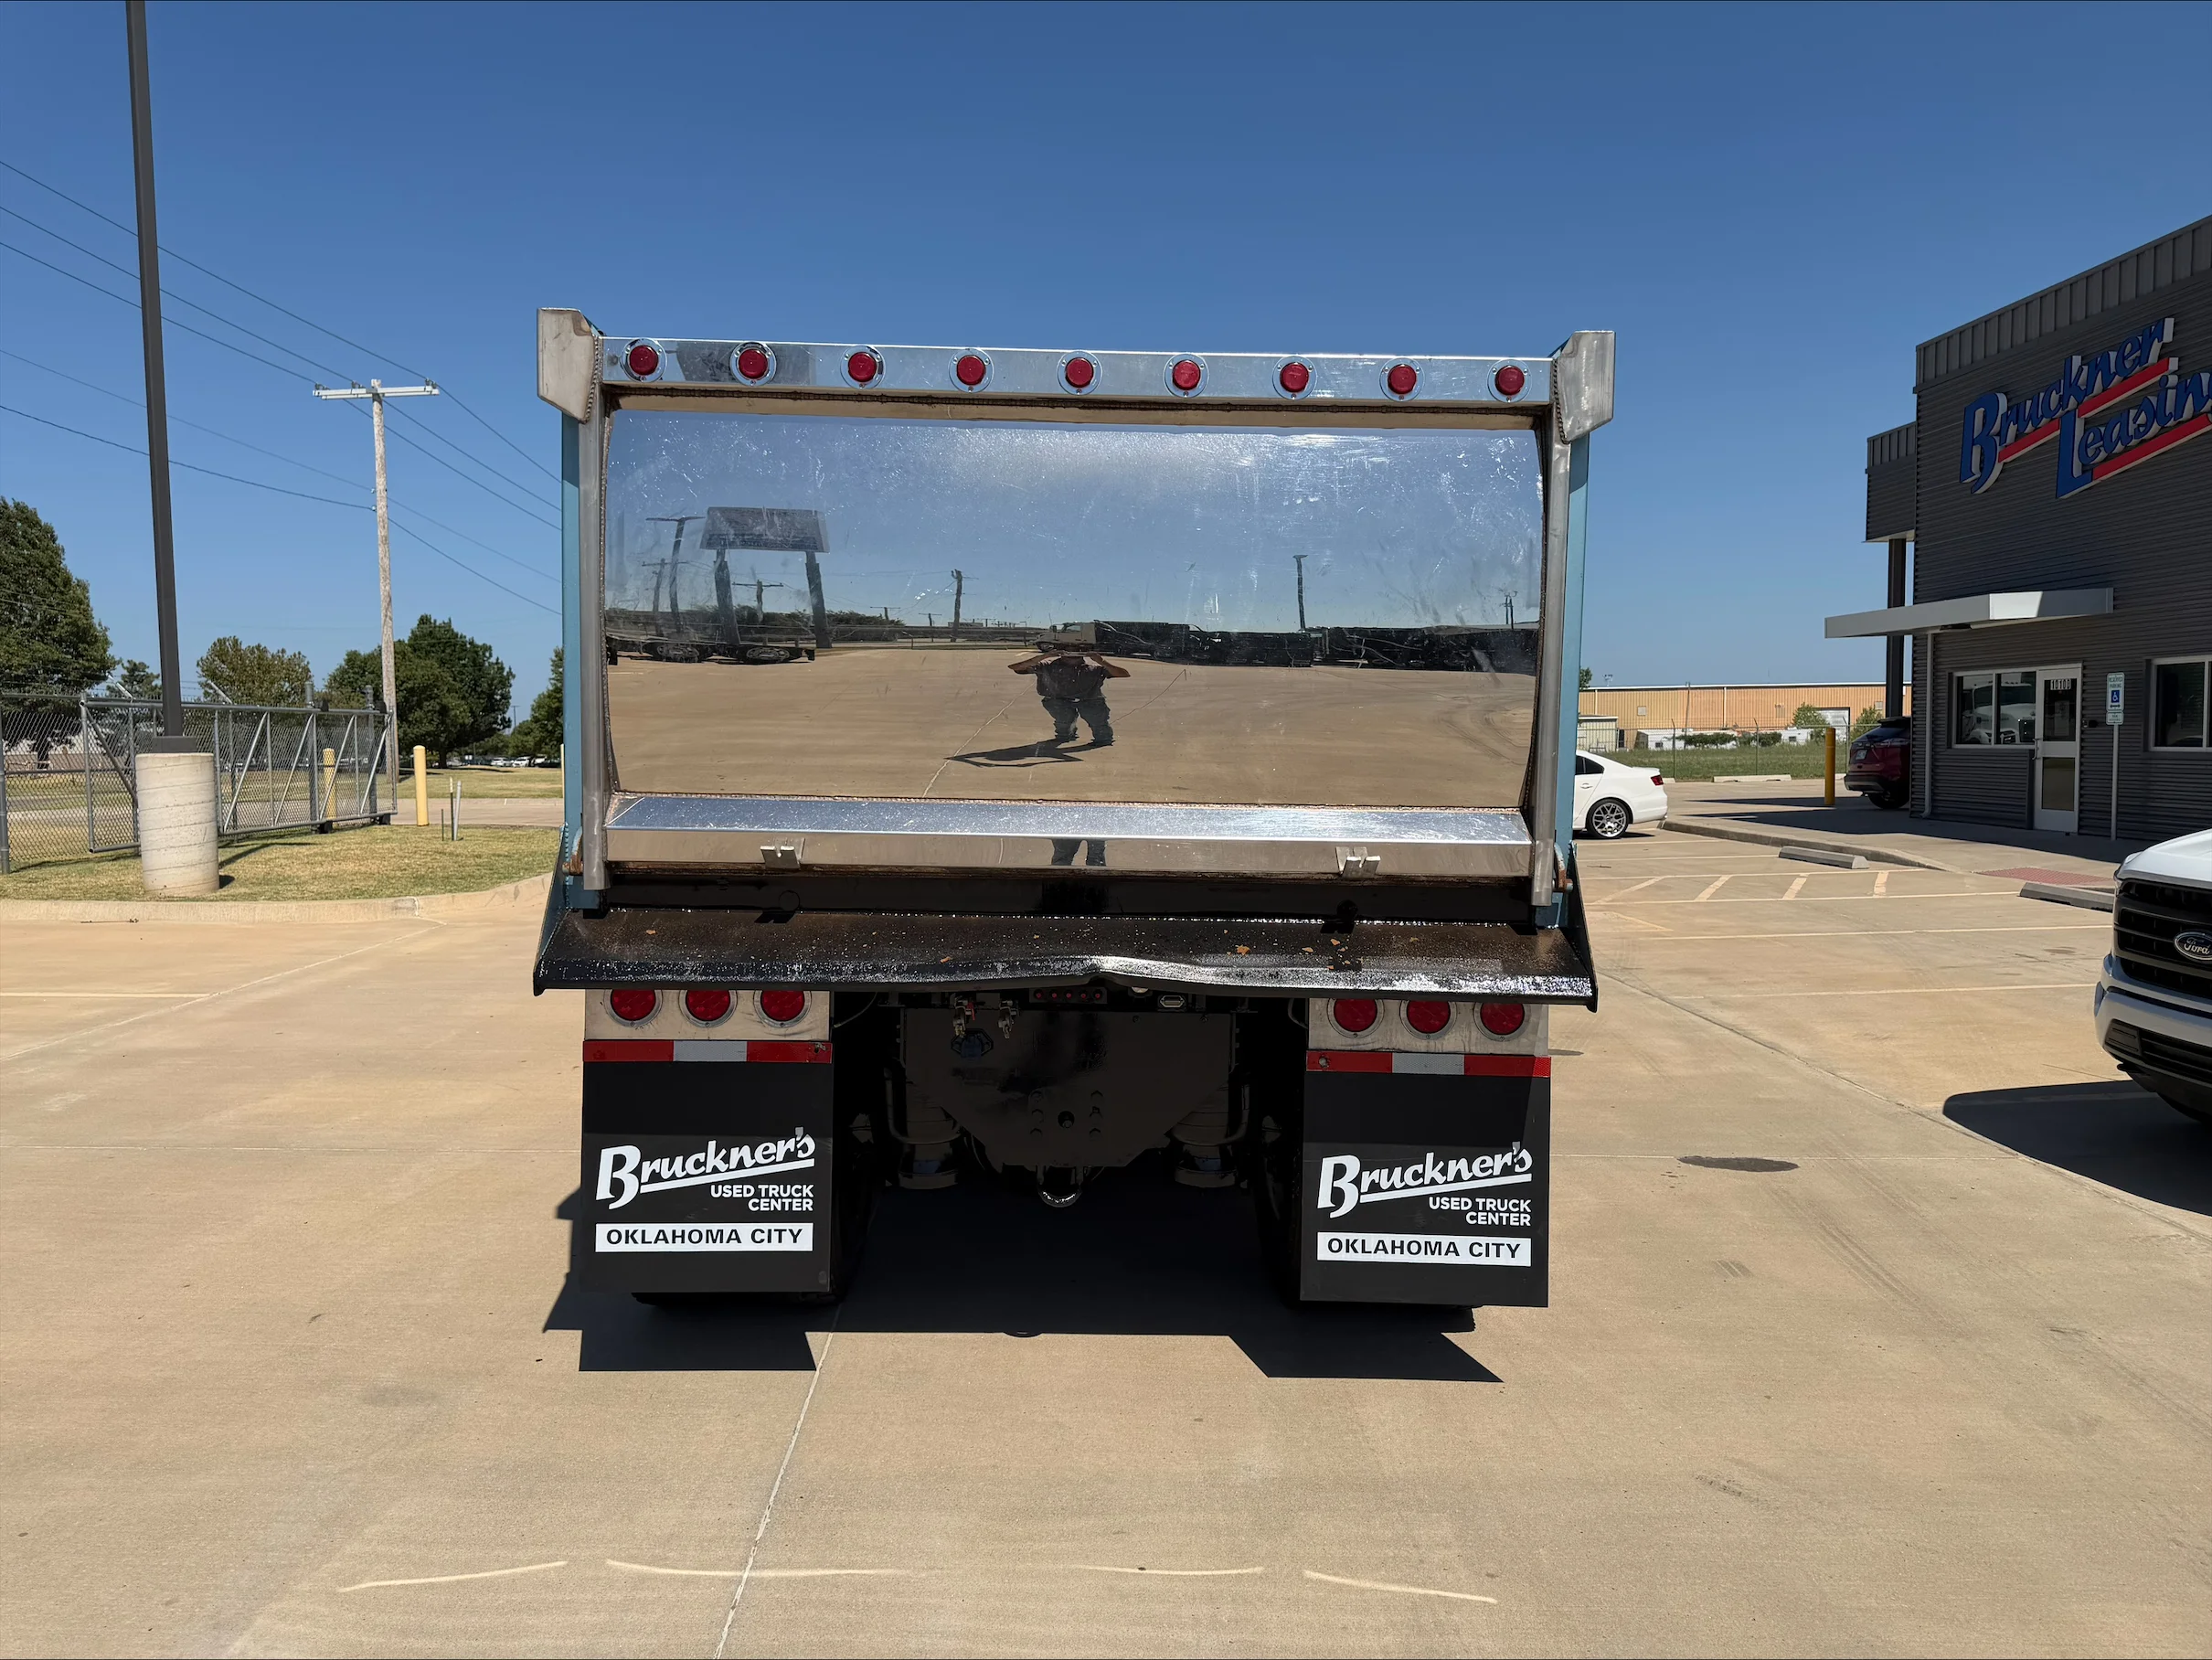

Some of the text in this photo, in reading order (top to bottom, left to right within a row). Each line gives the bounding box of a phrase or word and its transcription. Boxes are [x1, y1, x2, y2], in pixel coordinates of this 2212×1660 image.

[1960, 317, 2175, 495] Bruckner
[2056, 372, 2212, 499] Leasin
[2184, 937, 2211, 955] Ford
[595, 1126, 815, 1210] Bruckner's
[1317, 1141, 1533, 1219] Bruckner's
[710, 1184, 814, 1198] USED TRUCK
[748, 1197, 814, 1212] CENTER
[1429, 1196, 1532, 1213] USED TRUCK
[1465, 1211, 1532, 1227] CENTER
[606, 1228, 803, 1245] OKLAHOMA CITY
[1327, 1238, 1521, 1259] OKLAHOMA CITY
